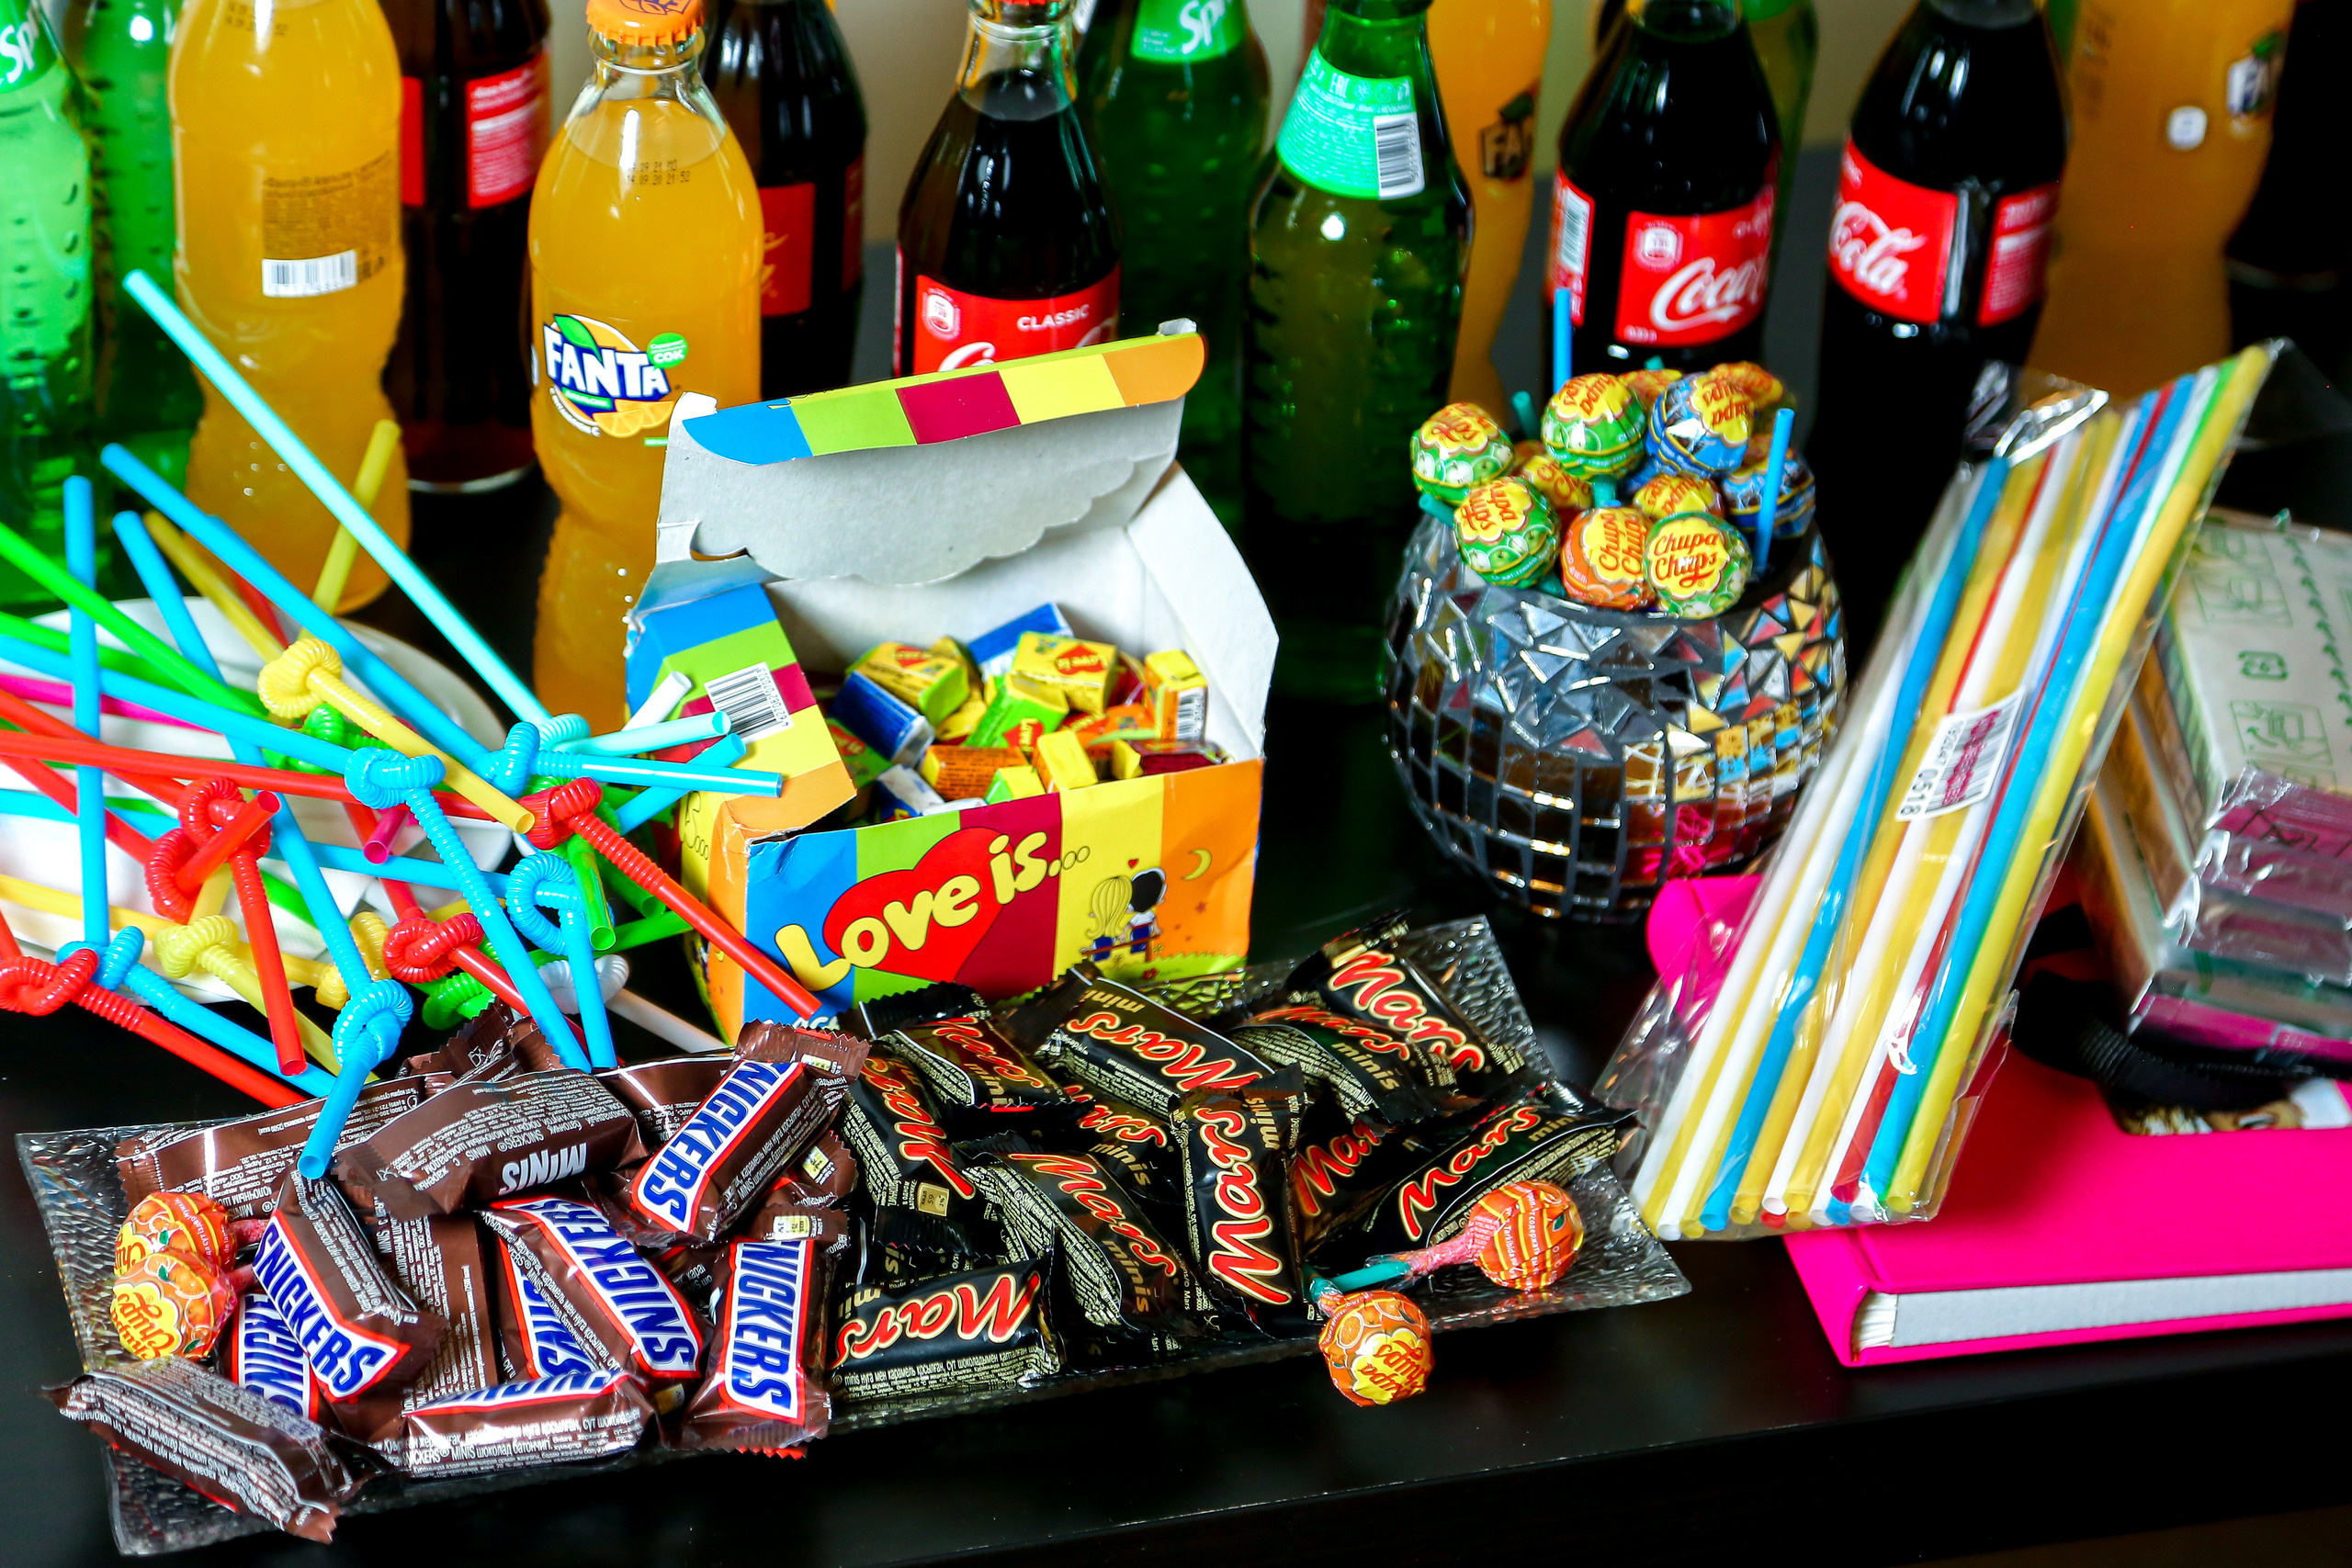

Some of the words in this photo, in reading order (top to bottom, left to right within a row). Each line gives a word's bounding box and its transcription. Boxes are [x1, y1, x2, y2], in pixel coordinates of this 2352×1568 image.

[1829, 200, 1928, 296] Cola
[1016, 304, 1090, 332] CLASSIC
[544, 324, 671, 399] FANTA
[1597, 509, 1618, 570] Chupa
[1654, 532, 1719, 557] Chupa
[1656, 552, 1719, 588] Chups
[766, 693, 787, 721] 627082
[1898, 762, 1939, 822] 0518
[774, 874, 982, 992] Love
[1066, 1010, 1262, 1092] Mars
[1331, 1041, 1399, 1090] minis
[546, 1120, 582, 1135] батончик
[584, 1106, 629, 1127] Шоколадный
[643, 1061, 793, 1224] NICKERS
[860, 1057, 975, 1200] Mars
[1242, 1097, 1280, 1149] minis
[464, 1142, 492, 1161] MINIS
[492, 1141, 592, 1196] MINIS
[1088, 1142, 1151, 1187] minis
[1295, 1119, 1382, 1219] Mar
[1399, 1103, 1542, 1239] Mars
[735, 1178, 757, 1201] MINIS
[928, 1194, 933, 1204] 59
[1009, 1153, 1176, 1277] Mars
[1193, 1108, 1292, 1304] Mars
[525, 1268, 545, 1292] MINIS
[537, 1270, 567, 1305] карамель
[561, 1300, 577, 1317] мен
[549, 1199, 697, 1367] SNICKERS
[1102, 1241, 1152, 1312] minis
[1182, 1290, 1191, 1310] Mars
[253, 1221, 379, 1392] SNICKERS
[731, 1240, 802, 1411] NICKERS
[828, 1271, 1041, 1370] Mars
[843, 1373, 860, 1385] minis
[874, 1371, 888, 1382] мен
[887, 1366, 915, 1381] карамель
